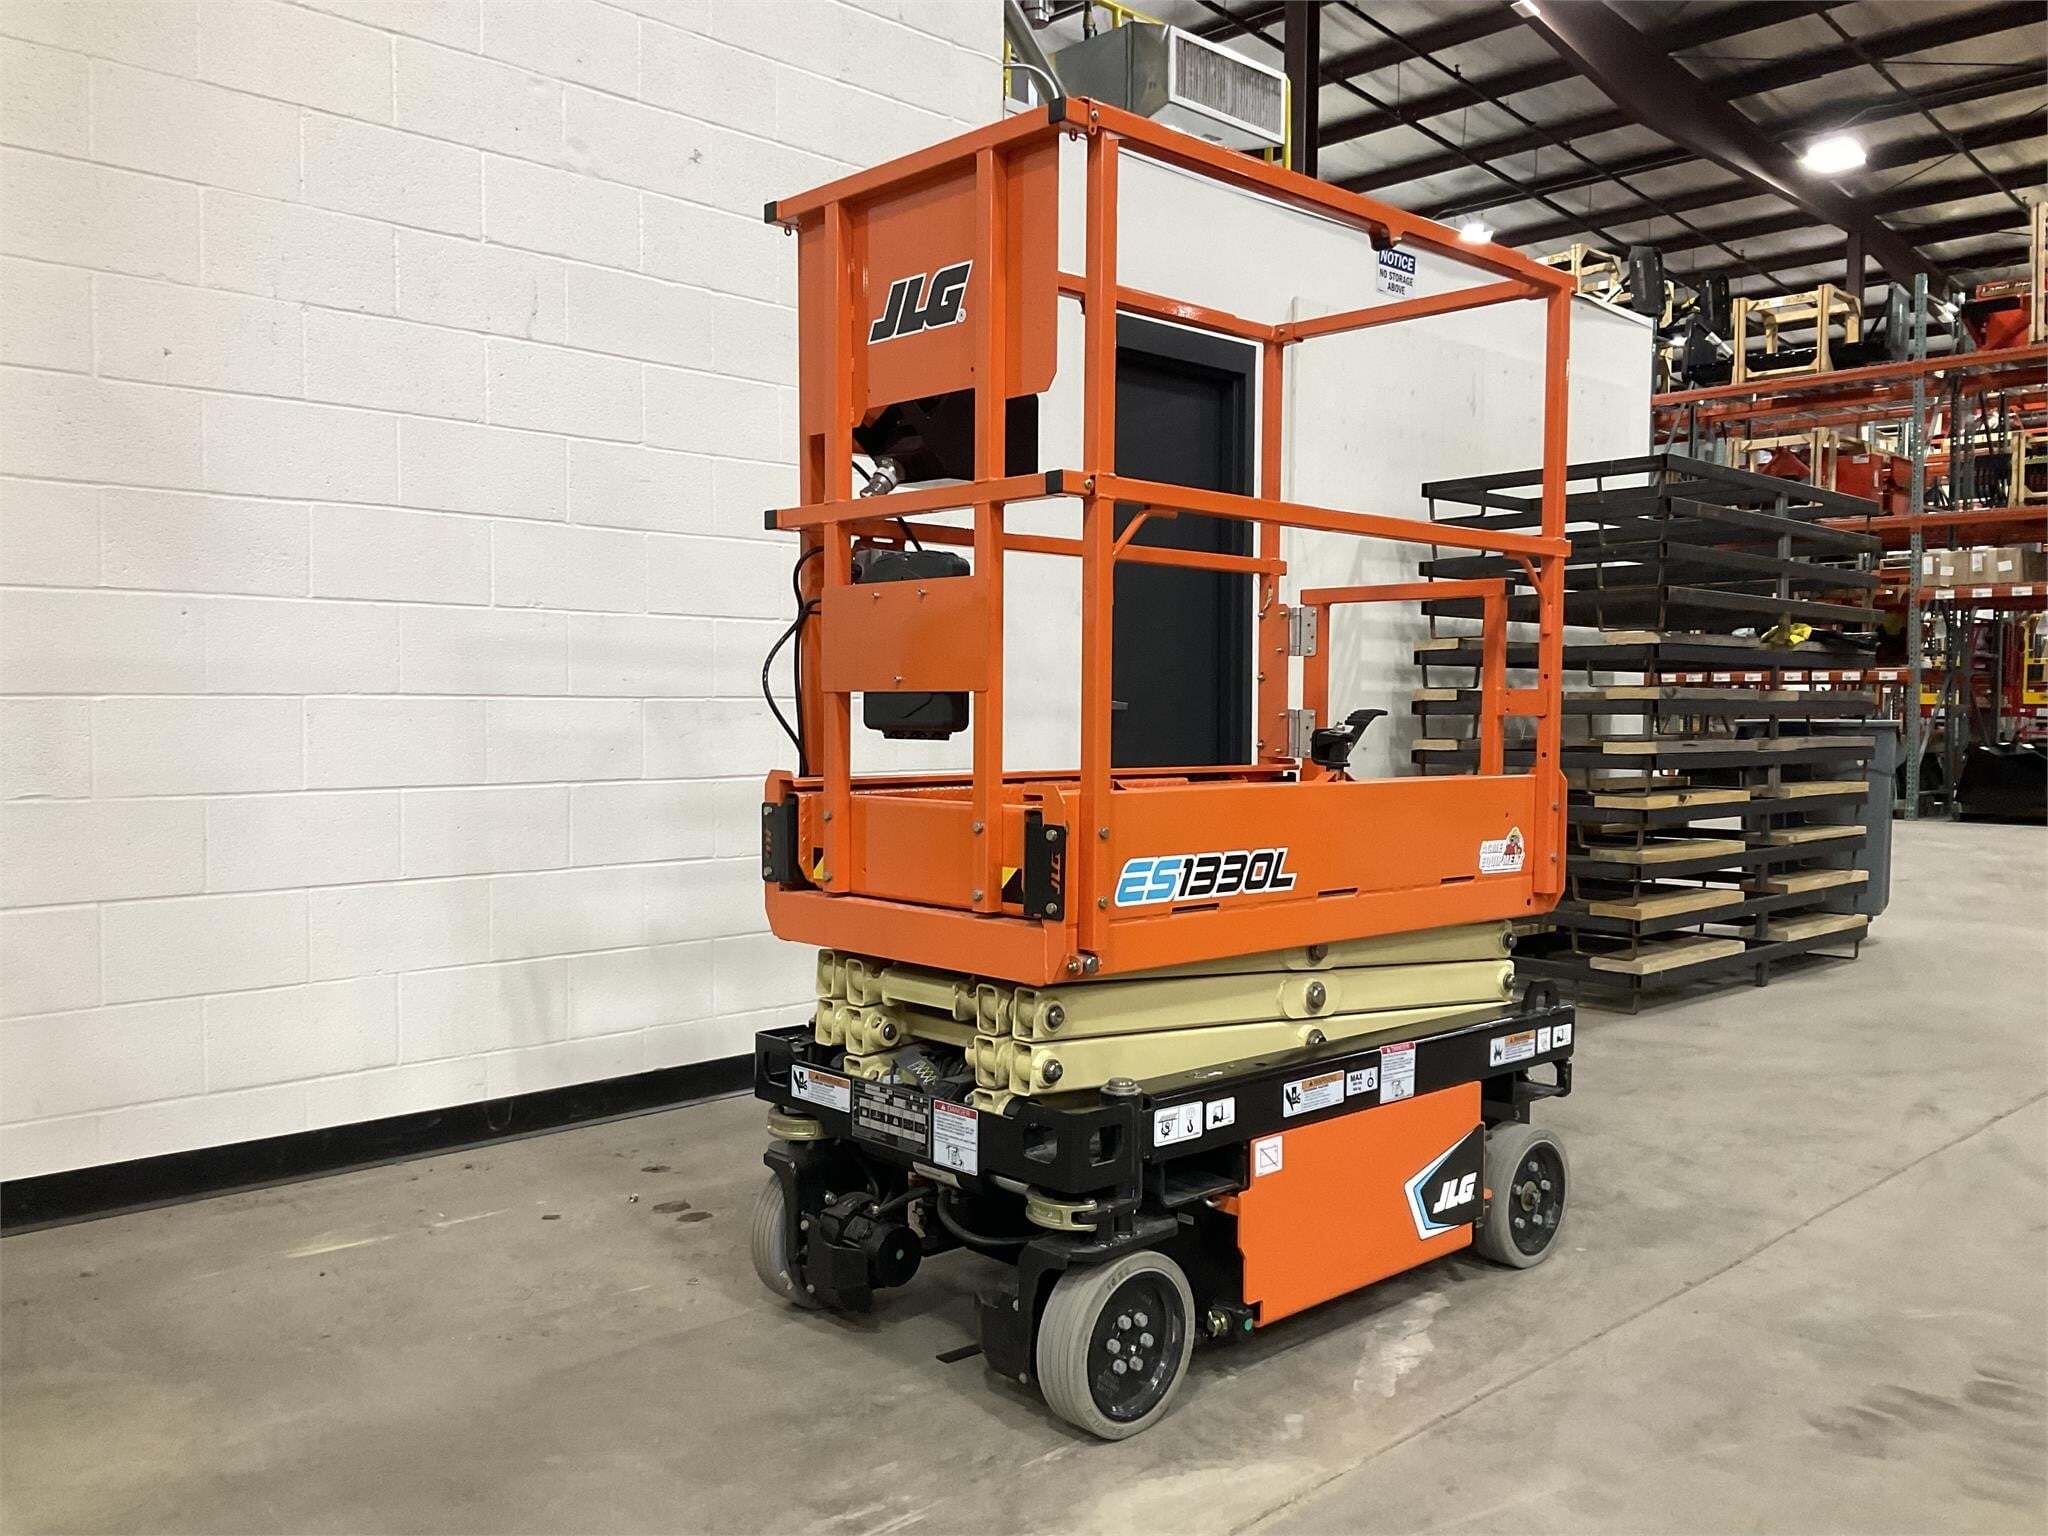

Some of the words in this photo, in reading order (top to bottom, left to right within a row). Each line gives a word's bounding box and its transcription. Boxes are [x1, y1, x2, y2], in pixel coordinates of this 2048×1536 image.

[1380, 250, 1414, 271] NOTICE
[1379, 268, 1387, 278] NO
[1389, 271, 1413, 287] STORAGE
[1387, 282, 1405, 295] ABOVE
[867, 259, 973, 345] JLG
[1115, 849, 1297, 906] ES1330L
[1350, 1073, 1362, 1082] MAX
[1432, 1172, 1477, 1214] JLG
